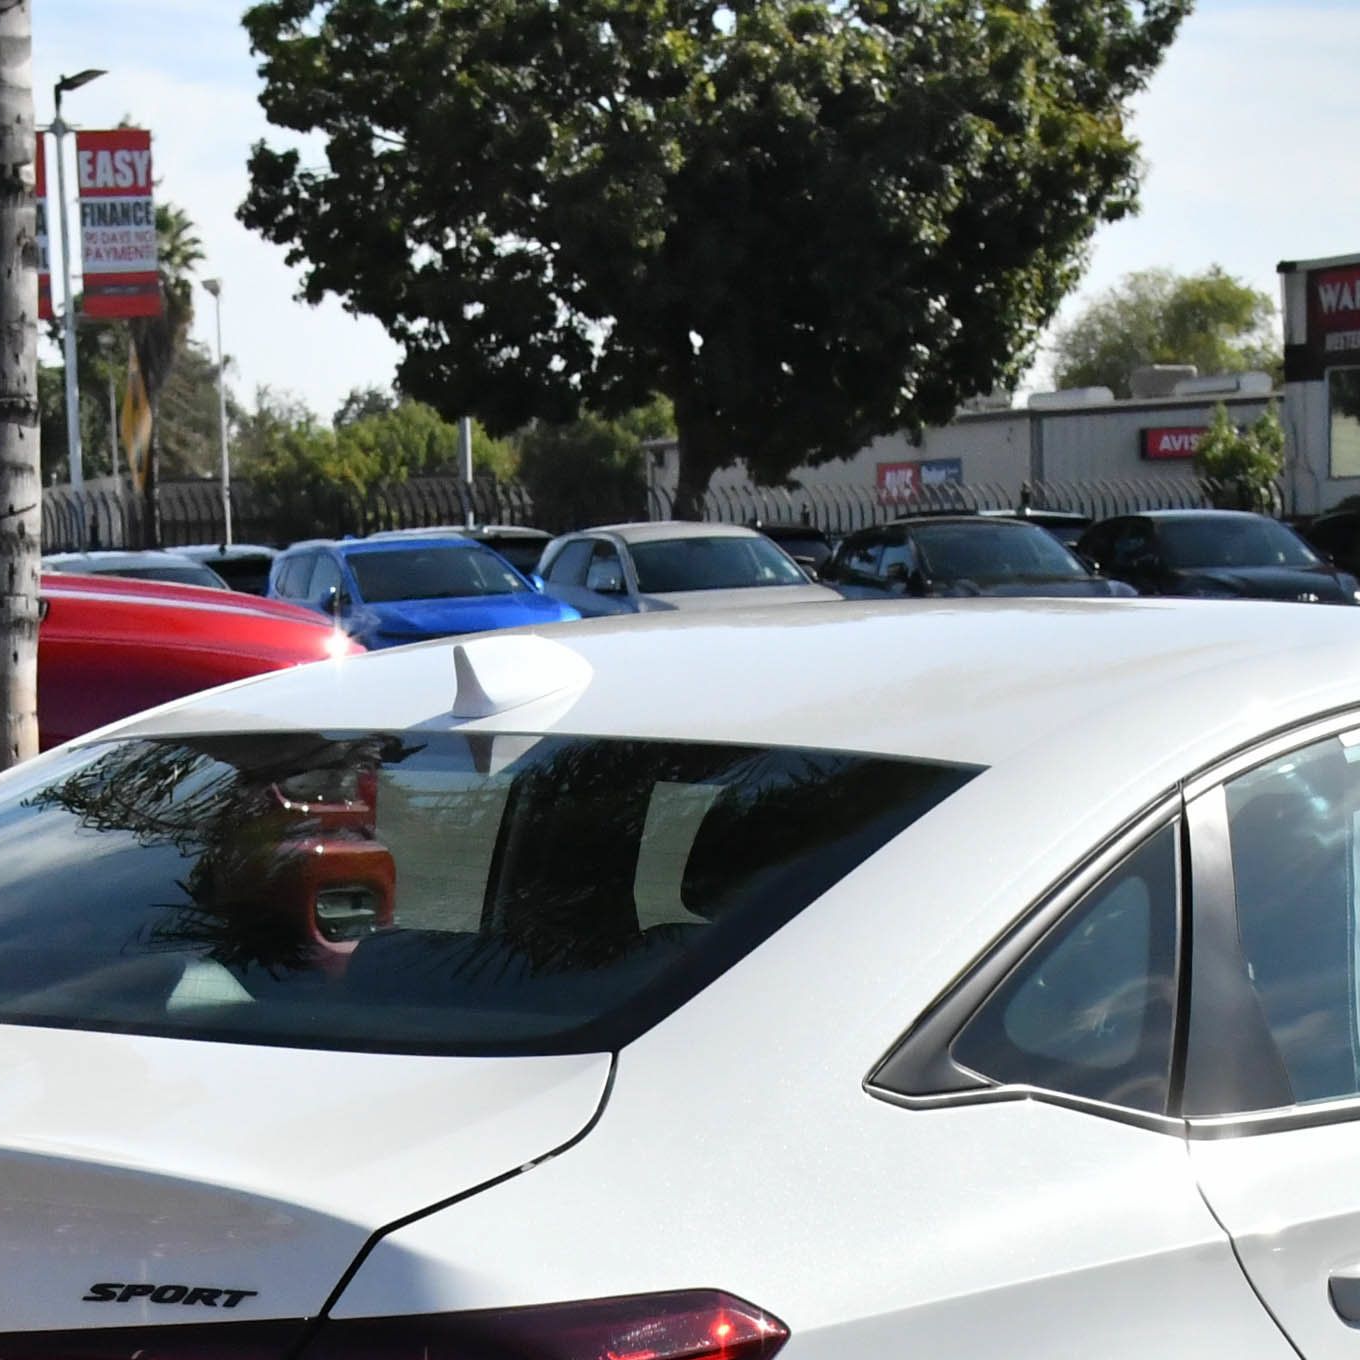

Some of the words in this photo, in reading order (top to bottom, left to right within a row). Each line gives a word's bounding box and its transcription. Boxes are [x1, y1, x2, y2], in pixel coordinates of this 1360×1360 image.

[79, 150, 151, 188] EASY
[81, 201, 153, 227] FINANCE
[82, 1283, 259, 1308] SPORT
